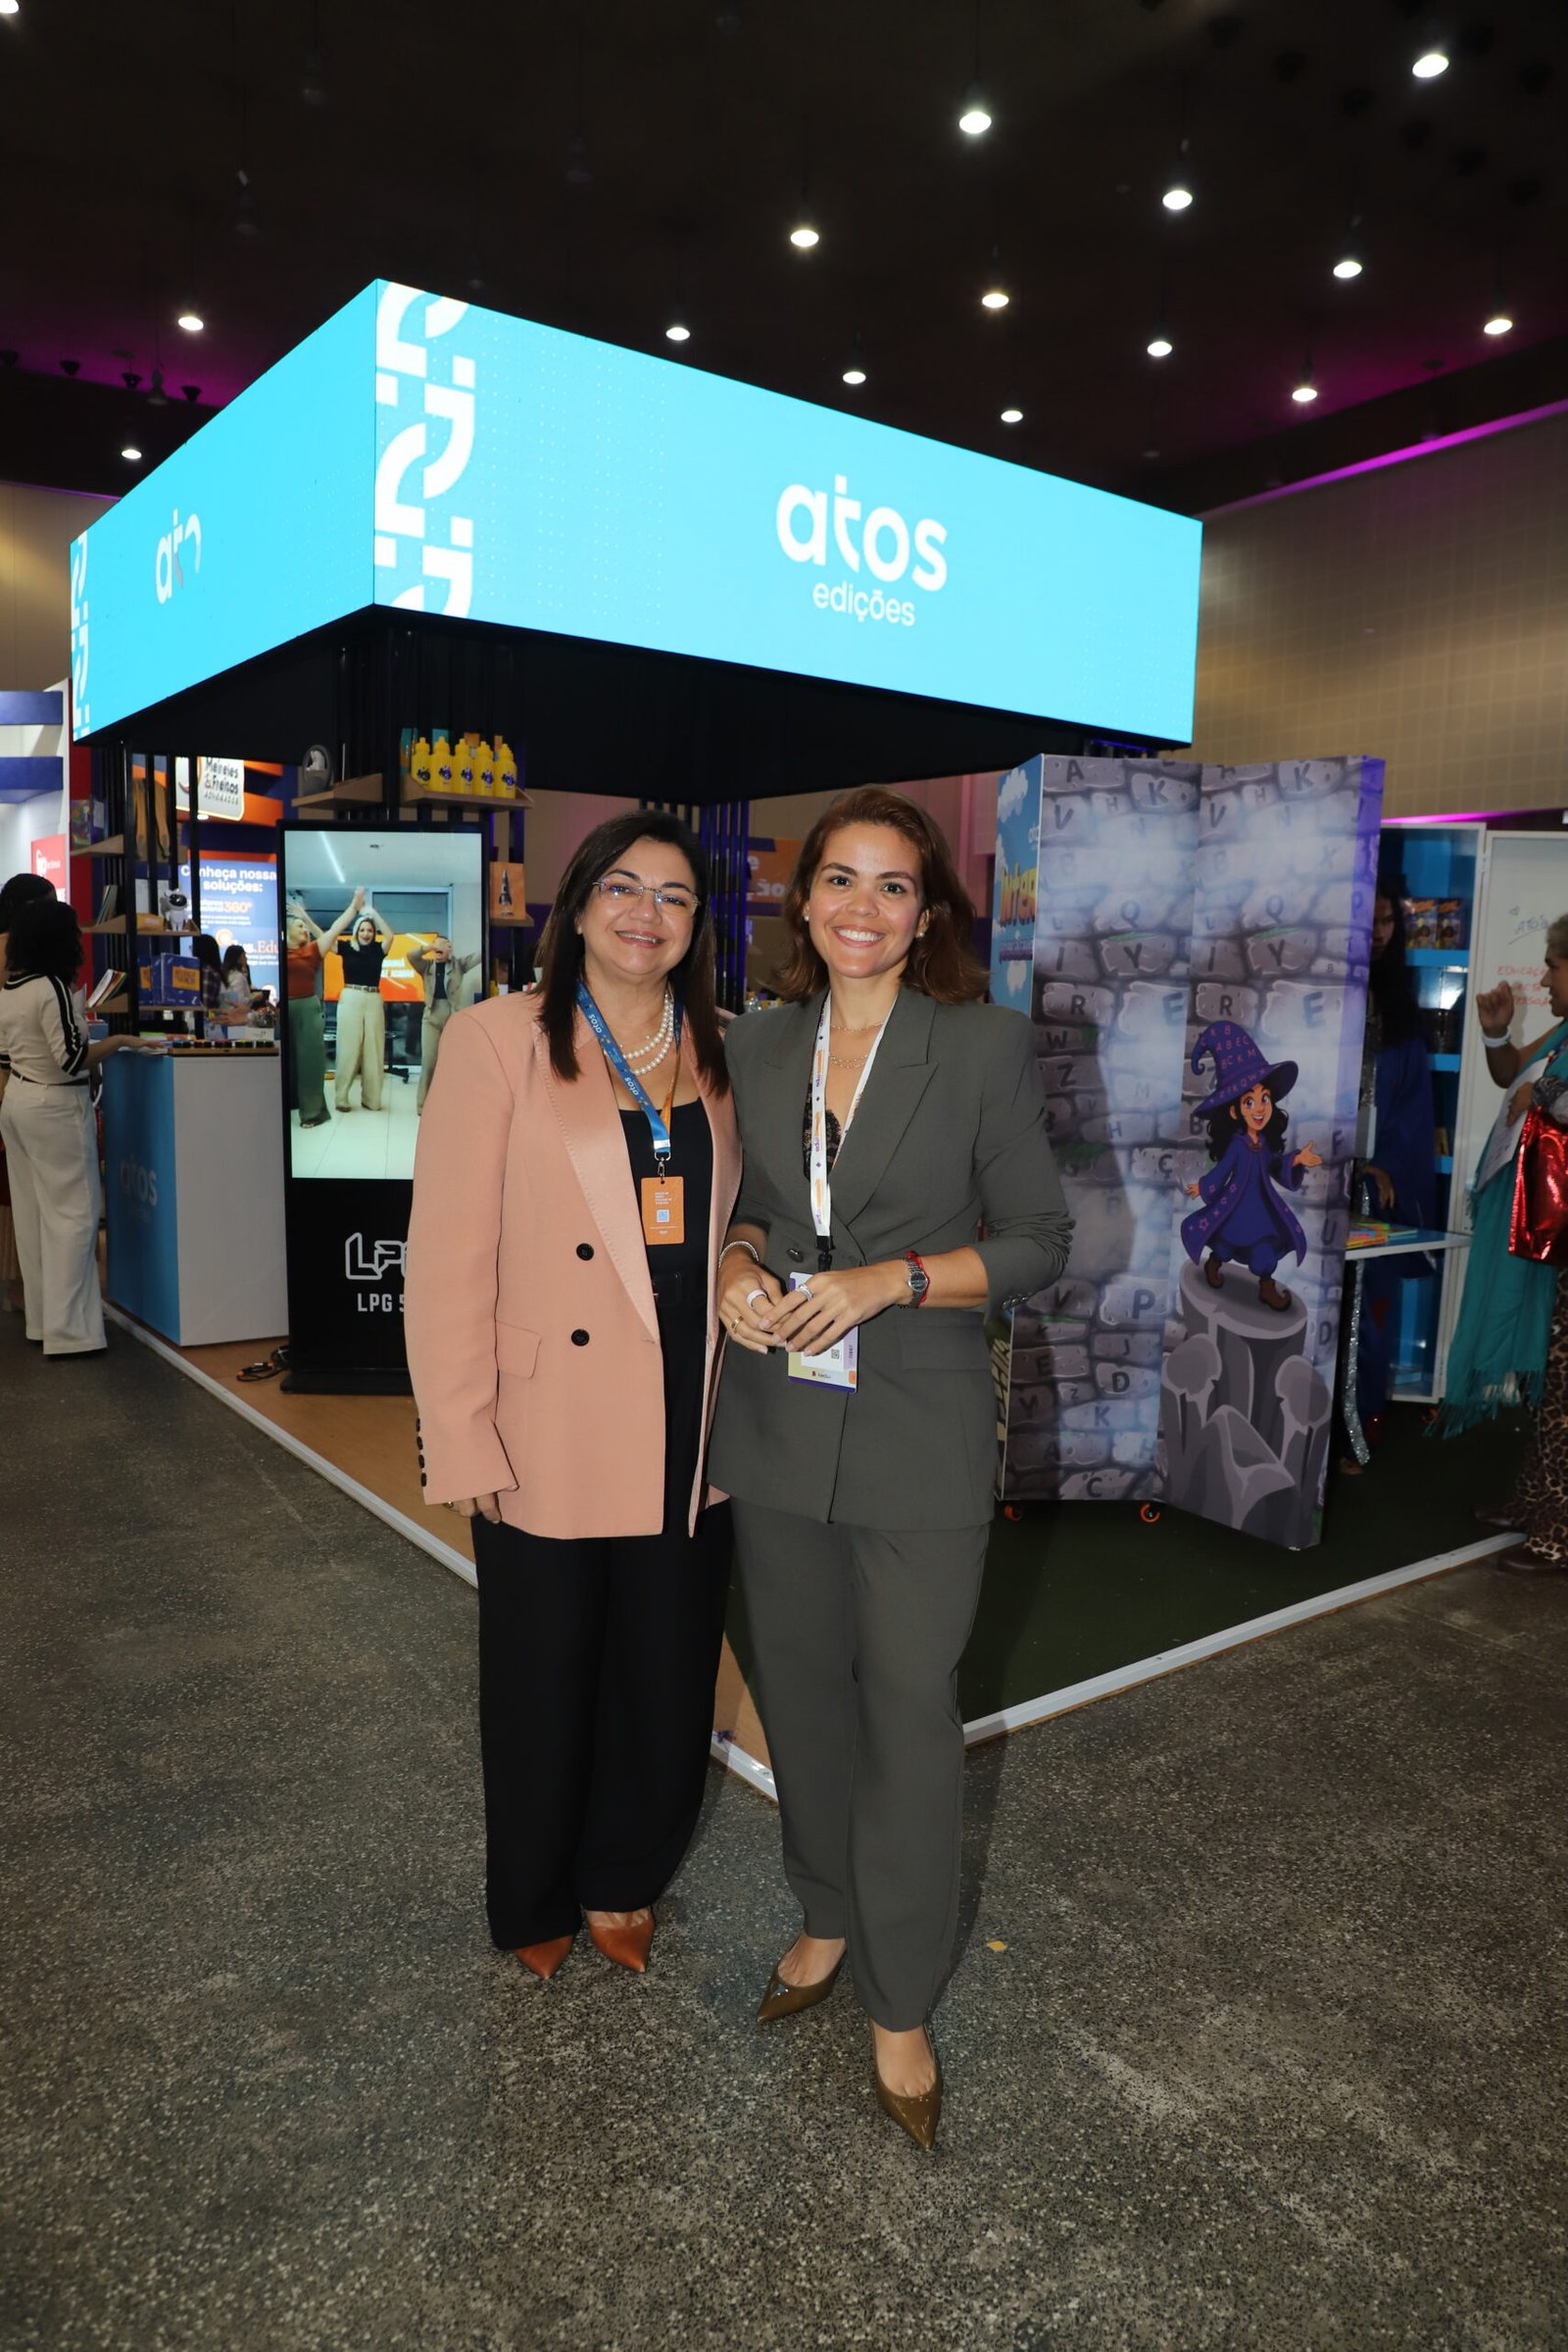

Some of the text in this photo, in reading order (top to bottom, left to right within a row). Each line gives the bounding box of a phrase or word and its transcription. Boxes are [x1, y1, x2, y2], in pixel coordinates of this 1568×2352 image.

[776, 473, 948, 592] atos
[812, 581, 915, 626] edições
[1067, 760, 1084, 782] A
[1295, 762, 1313, 791] K
[1105, 796, 1117, 812] H
[1149, 780, 1168, 806] K
[1255, 787, 1266, 805] H
[1054, 805, 1074, 829] V
[1210, 803, 1226, 828] V
[180, 864, 277, 881] Cnheça nossa
[203, 880, 264, 894] soluções:
[1120, 900, 1140, 928] Q
[1265, 895, 1284, 923] Q
[1123, 943, 1143, 968] Y
[1268, 939, 1286, 966] Y
[1070, 995, 1086, 1015] R
[1163, 992, 1184, 1026] E
[1219, 995, 1232, 1016] R
[1303, 992, 1326, 1028] E
[589, 1013, 603, 1034] atos
[1047, 1031, 1067, 1049] W
[624, 1076, 639, 1096] atos
[1056, 1062, 1075, 1086] Z
[1321, 1218, 1337, 1246] U
[345, 1232, 408, 1280] LP
[358, 1293, 392, 1312] LPG
[1054, 1287, 1071, 1308] V
[1132, 1289, 1155, 1319] P
[1319, 1321, 1332, 1345] D
[1112, 1372, 1129, 1393] D
[1095, 1406, 1109, 1426] K
[1087, 1477, 1102, 1497] C
